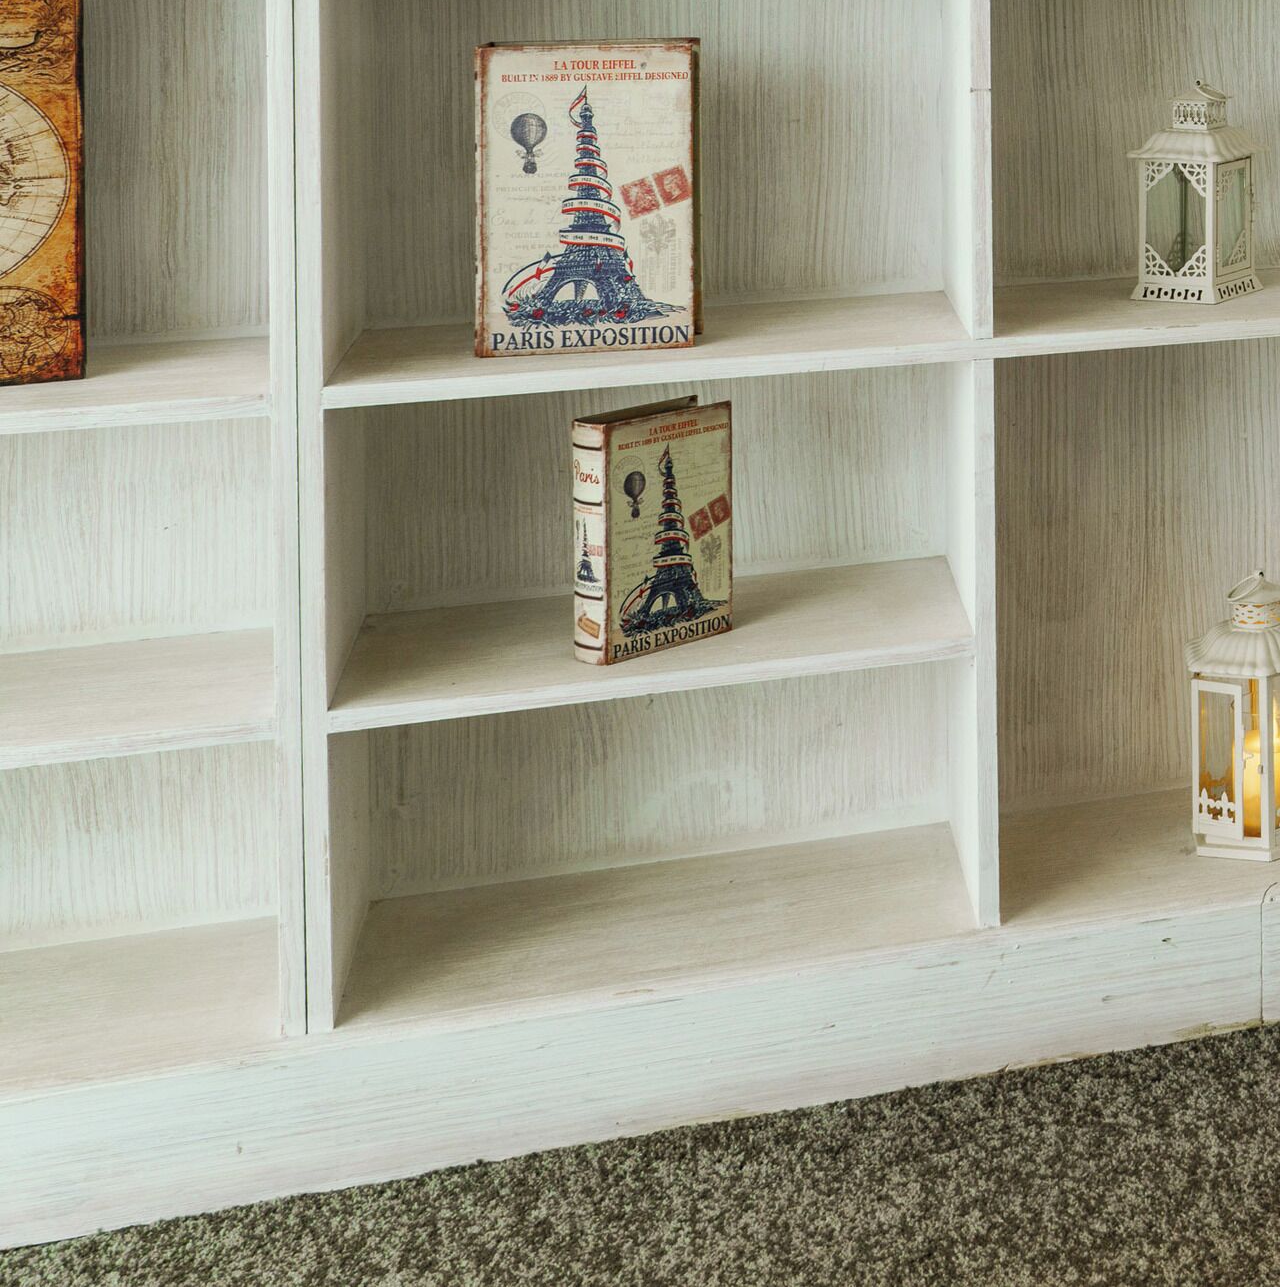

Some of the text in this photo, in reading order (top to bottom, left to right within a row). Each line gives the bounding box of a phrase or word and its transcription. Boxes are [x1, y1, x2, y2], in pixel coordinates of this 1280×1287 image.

[501, 74, 527, 83] BUILT
[541, 73, 558, 82] 1889
[560, 73, 572, 82] BY
[573, 72, 613, 82] GUSTAVE
[615, 72, 643, 81] EIFFEL
[645, 71, 689, 81] DESIGNED
[554, 60, 637, 71] LA TOUR EIFFEL
[491, 324, 690, 352] PARIS EXPOSITION
[573, 458, 601, 485] Paris
[613, 613, 732, 659] PARIS EXPOSITION
